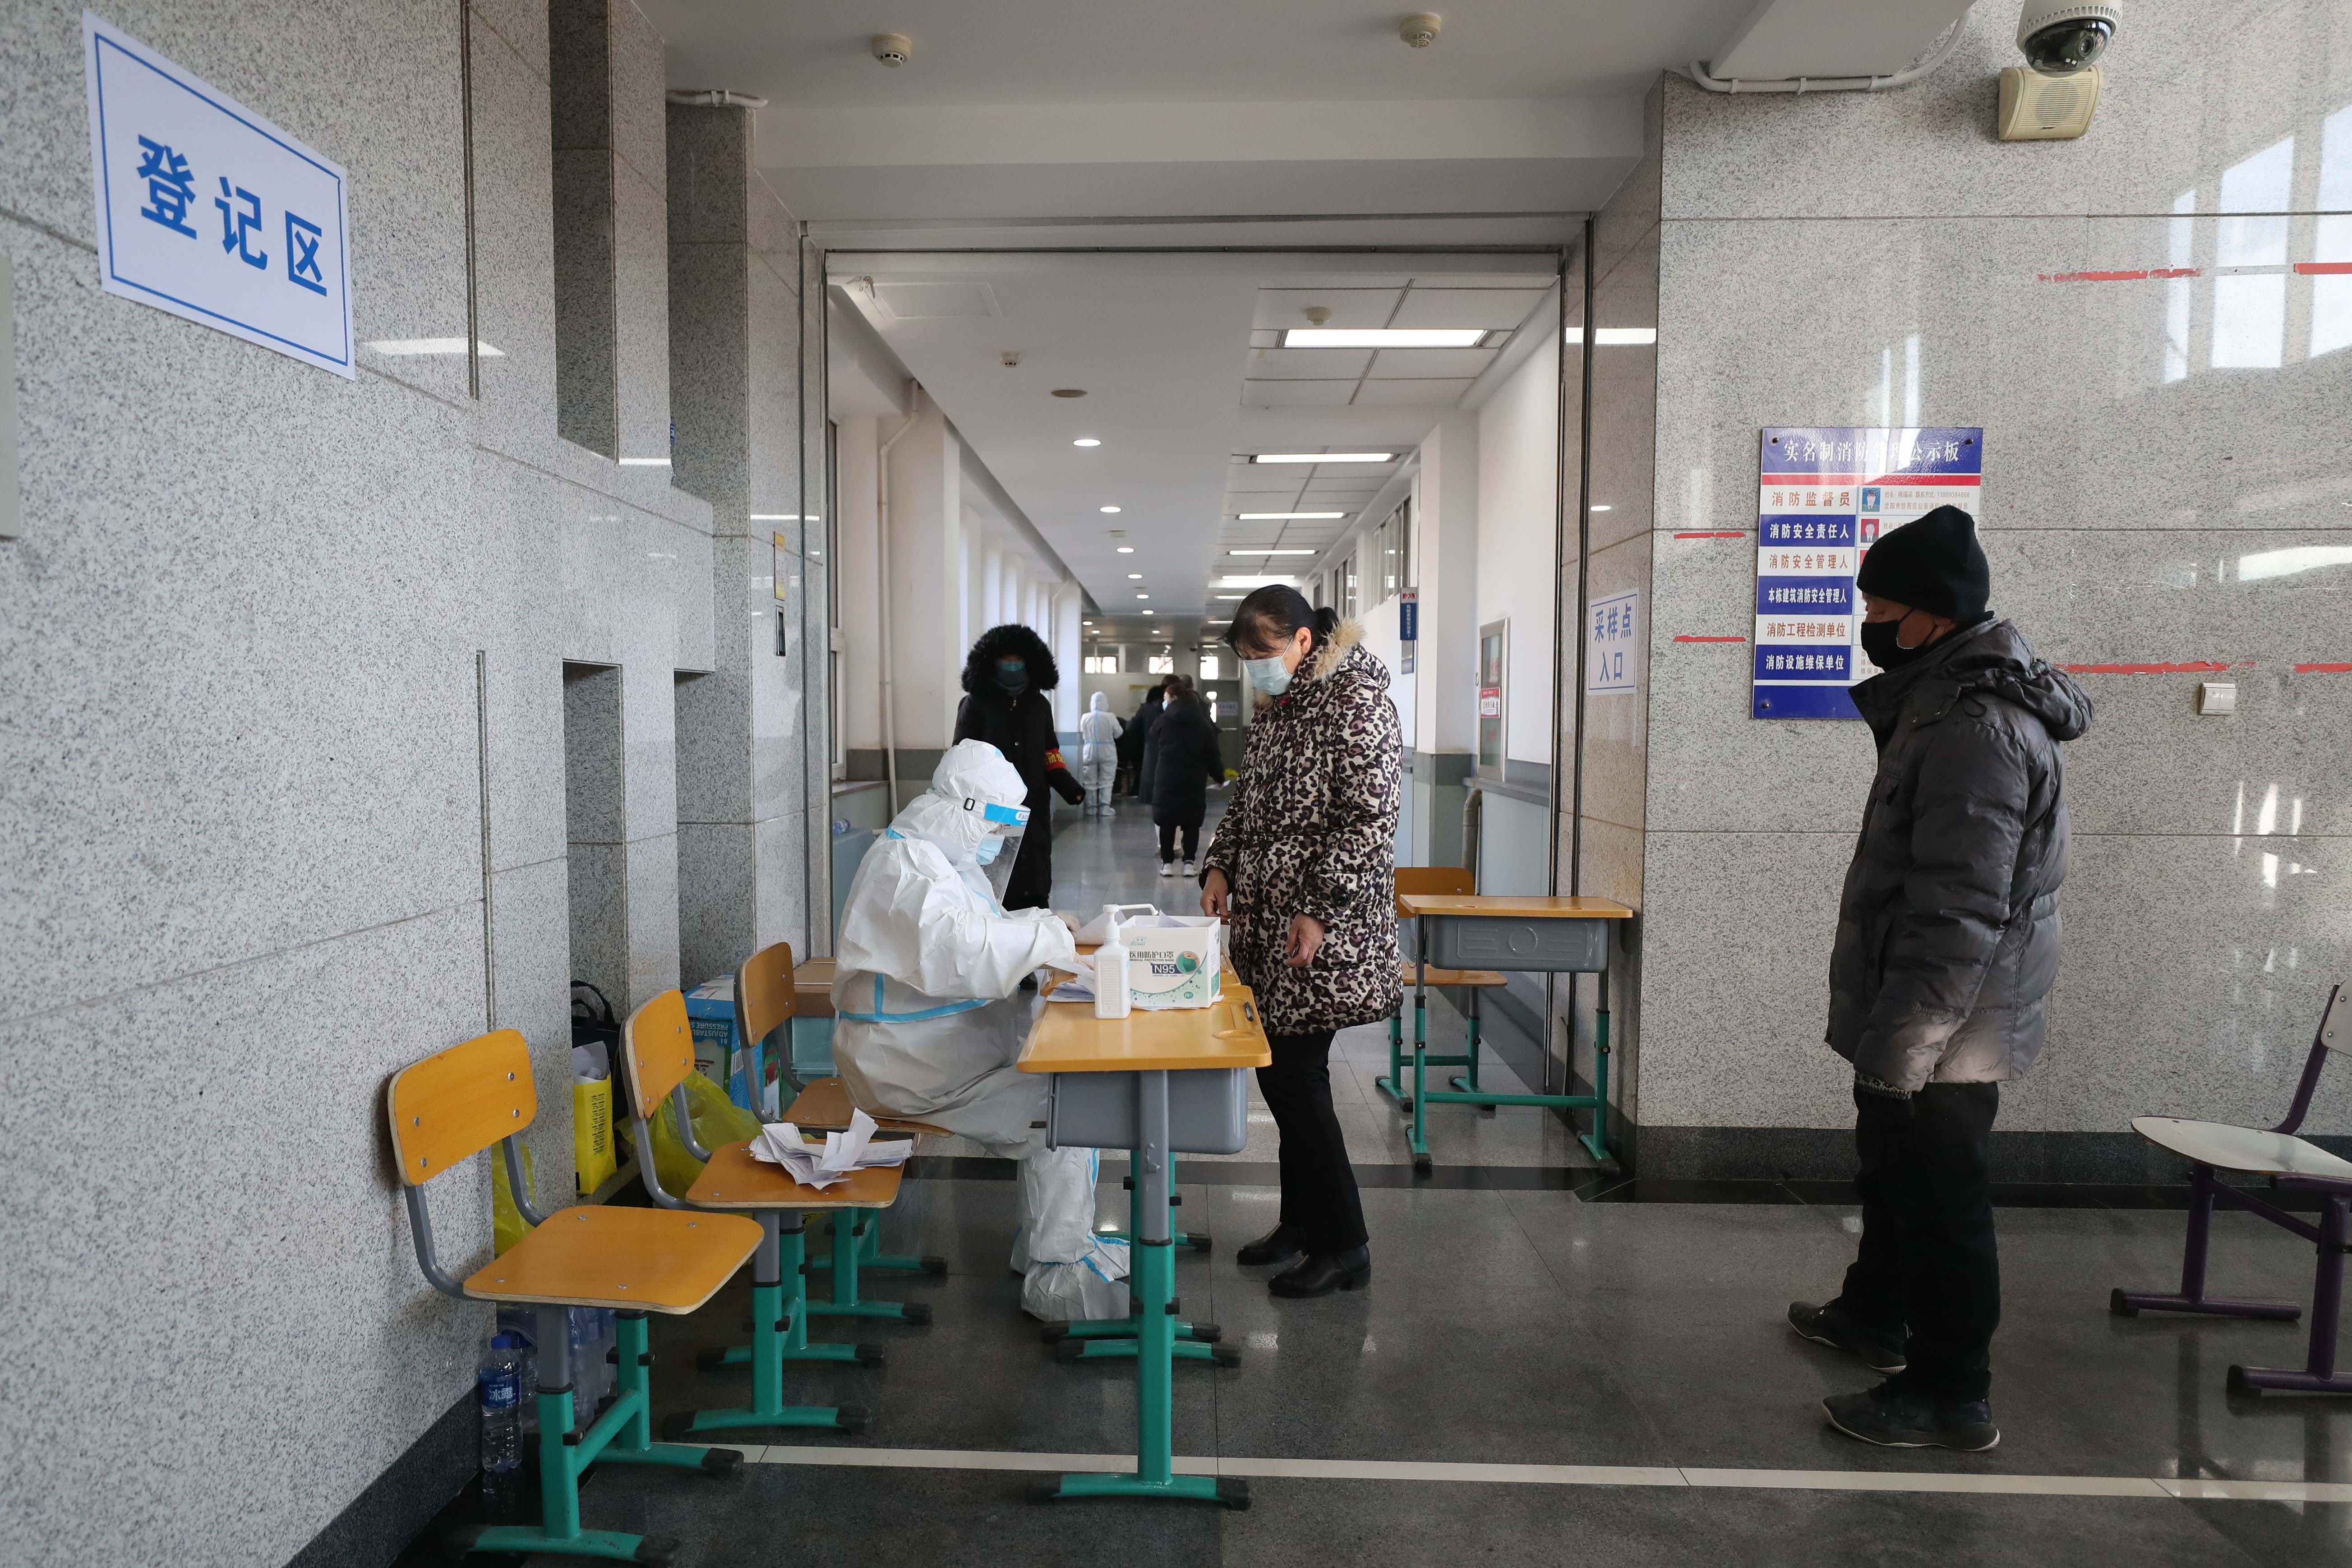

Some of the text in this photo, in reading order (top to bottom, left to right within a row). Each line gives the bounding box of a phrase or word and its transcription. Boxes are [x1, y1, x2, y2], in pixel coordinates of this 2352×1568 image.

[136, 134, 327, 297] 登记区
[1772, 491, 1850, 507] 消防监督员
[1770, 523, 1849, 539] 消防安全责任人
[1769, 553, 1848, 569] 消防安全管理人
[1768, 587, 1847, 603] 本栋建筑消防安全管理人
[1595, 603, 1631, 643] 采样点
[1767, 622, 1845, 638] 消防工程检测单位
[1600, 651, 1623, 682] 入口
[1766, 655, 1844, 671] 消防设施维保单位
[1130, 950, 1174, 959] 医用防护口罩
[1154, 964, 1175, 973] N95
